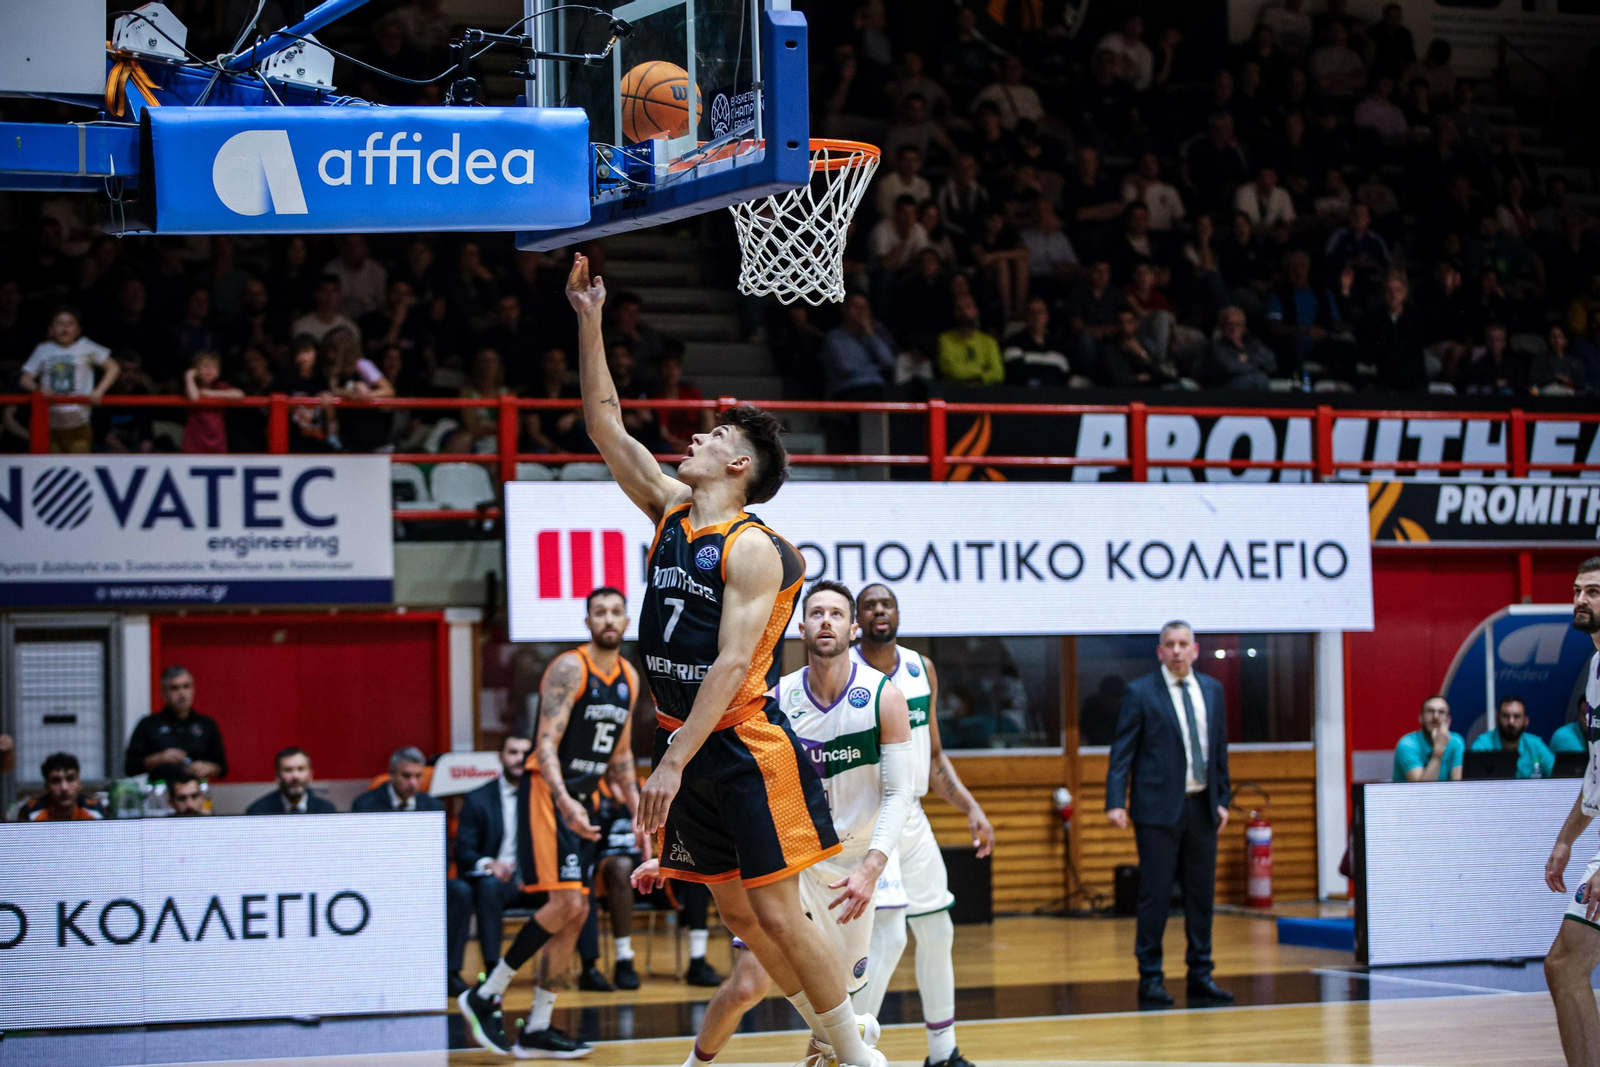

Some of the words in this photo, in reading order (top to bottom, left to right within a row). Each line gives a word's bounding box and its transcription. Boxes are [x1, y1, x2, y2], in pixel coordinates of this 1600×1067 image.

[318, 131, 535, 186] affidea
[207, 532, 339, 558] engineering
[1108, 540, 1349, 581] ΚΟΛΛΕΓΙΟ
[664, 597, 685, 643] 7
[672, 662, 713, 680] FRIG
[592, 722, 616, 754] 15
[810, 745, 862, 763] Uncaja
[56, 890, 371, 948] ΚΟΛΛΕΓΙΟ
